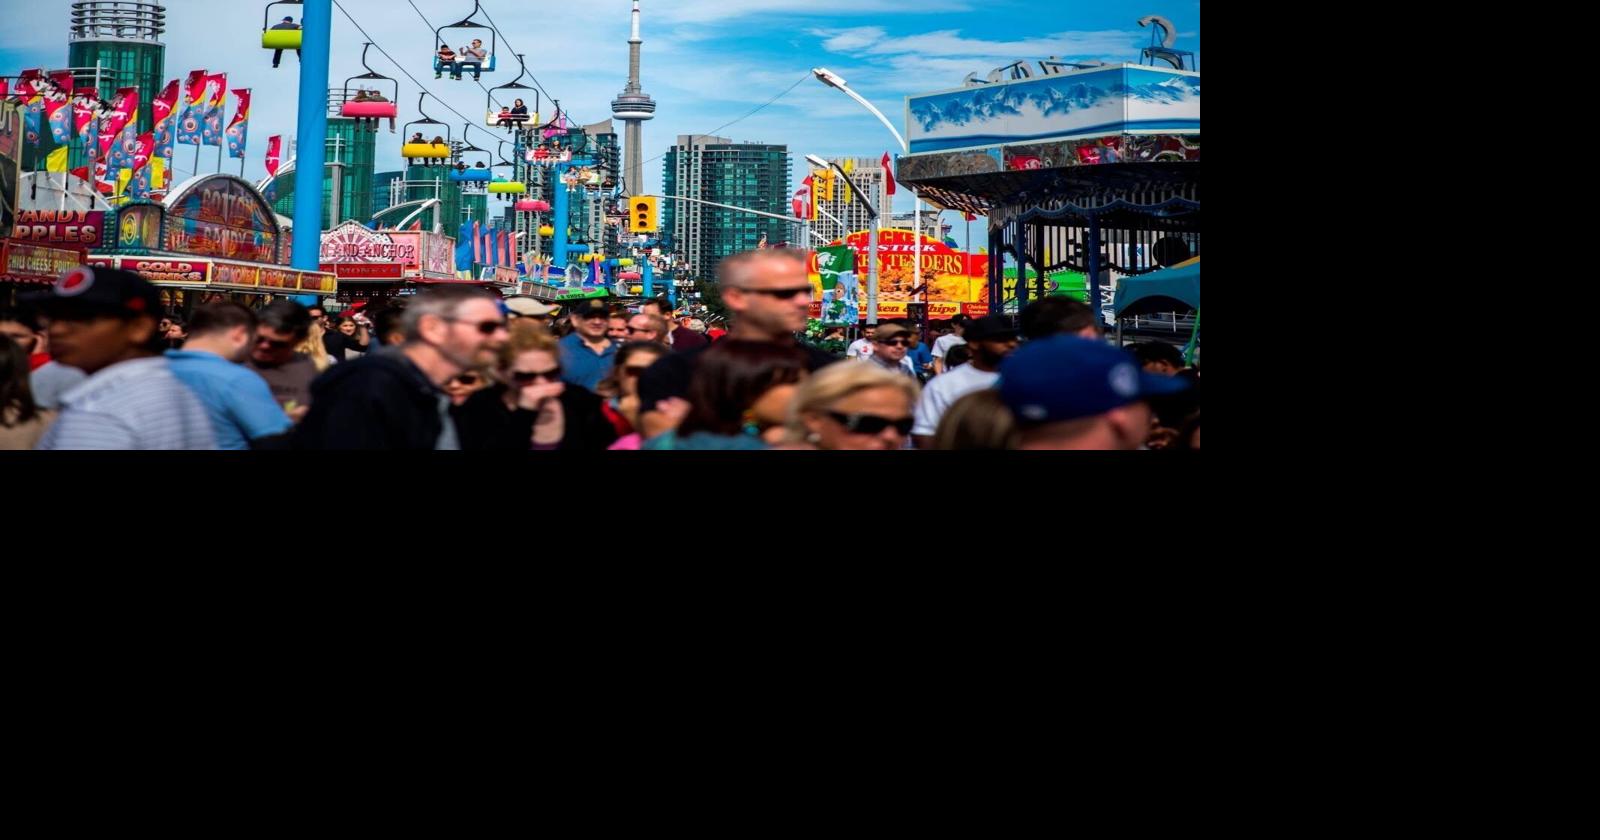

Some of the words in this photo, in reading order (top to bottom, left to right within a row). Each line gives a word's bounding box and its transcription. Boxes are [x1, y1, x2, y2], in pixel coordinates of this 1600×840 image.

[17, 209, 88, 223] ANDY
[15, 225, 96, 243] PPLES
[361, 243, 415, 260] ANCHOR
[27, 256, 52, 272] CHEESE
[136, 261, 193, 273] COLD
[138, 270, 202, 281] RINKS
[927, 304, 957, 315] hips
